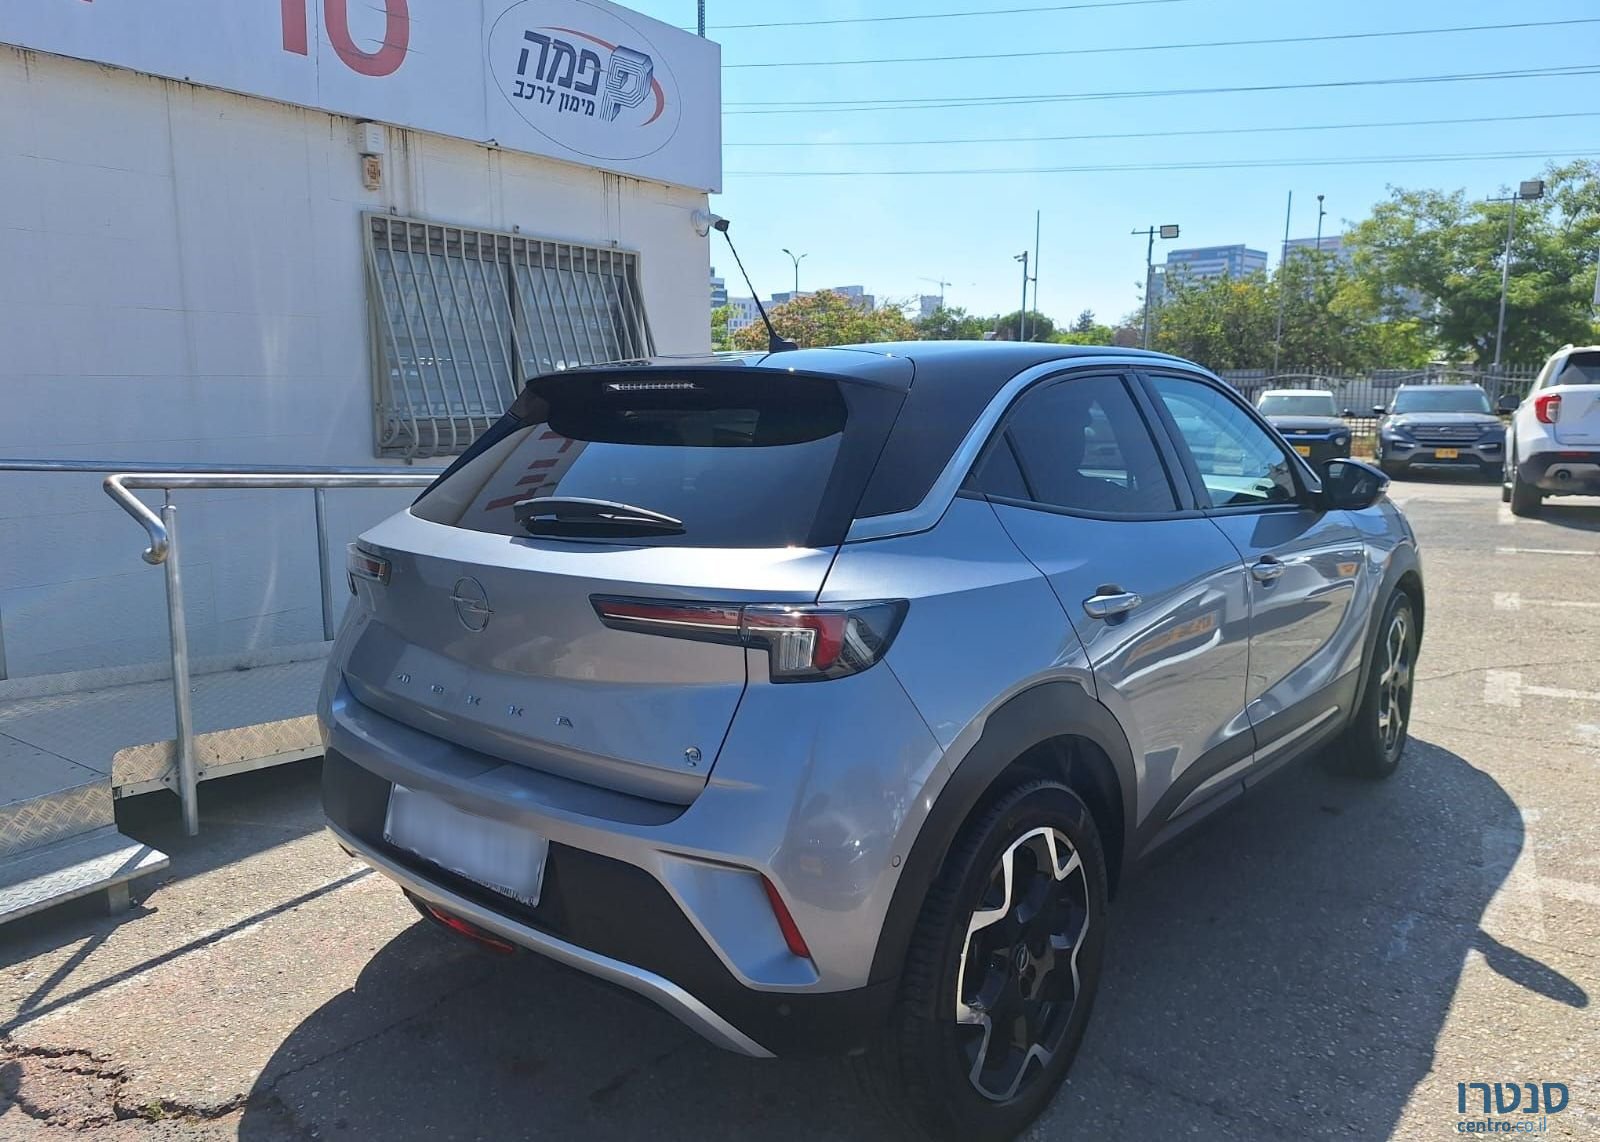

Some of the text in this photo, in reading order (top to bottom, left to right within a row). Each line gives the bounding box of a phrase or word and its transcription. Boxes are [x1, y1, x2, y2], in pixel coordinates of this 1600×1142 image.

[516, 30, 601, 96] פמה
[512, 80, 596, 117] מימון לרכב
